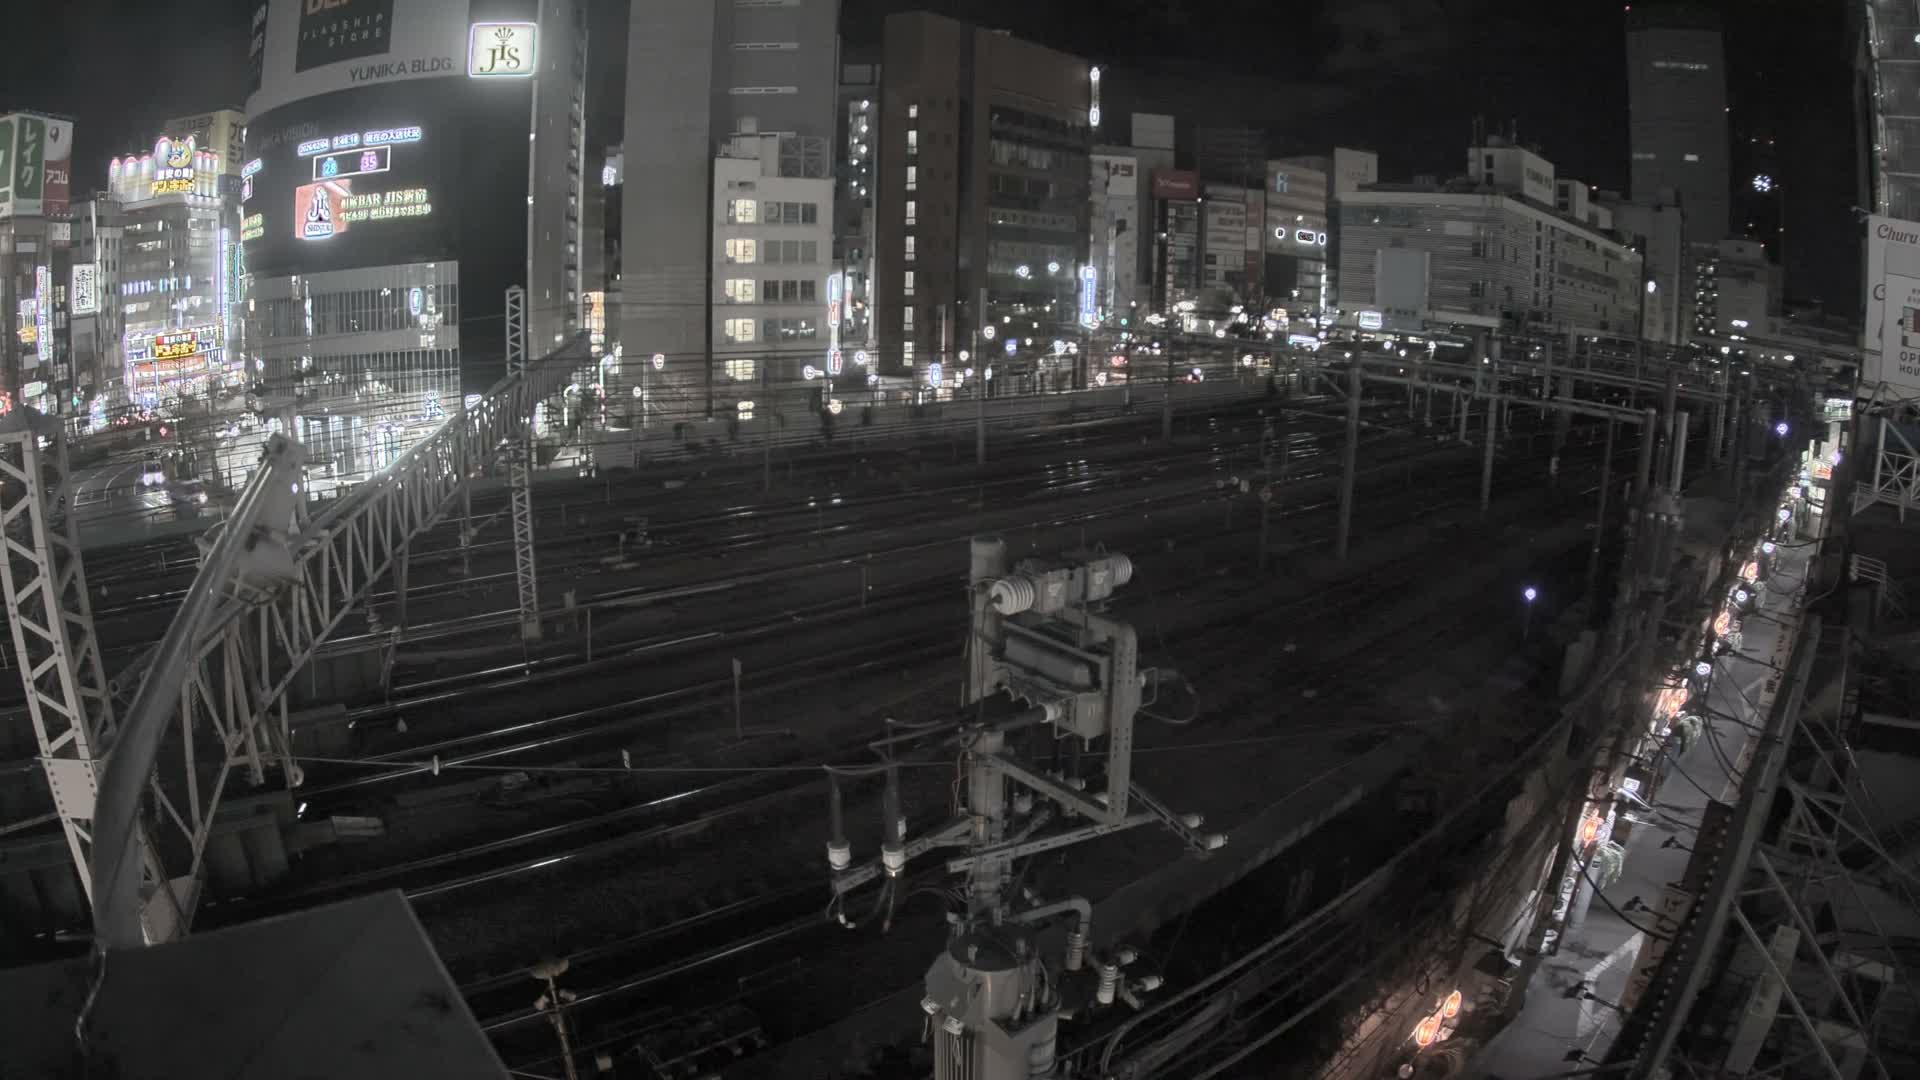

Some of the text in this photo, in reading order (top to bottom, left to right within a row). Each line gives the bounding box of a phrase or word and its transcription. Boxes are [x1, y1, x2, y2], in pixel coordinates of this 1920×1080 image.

[302, 13, 383, 40] FLAGSHIP
[328, 27, 381, 47] STORE
[480, 44, 521, 72] JIS
[350, 60, 408, 82] YUNIKA
[21, 120, 37, 188] レイク
[46, 169, 69, 184] アコム
